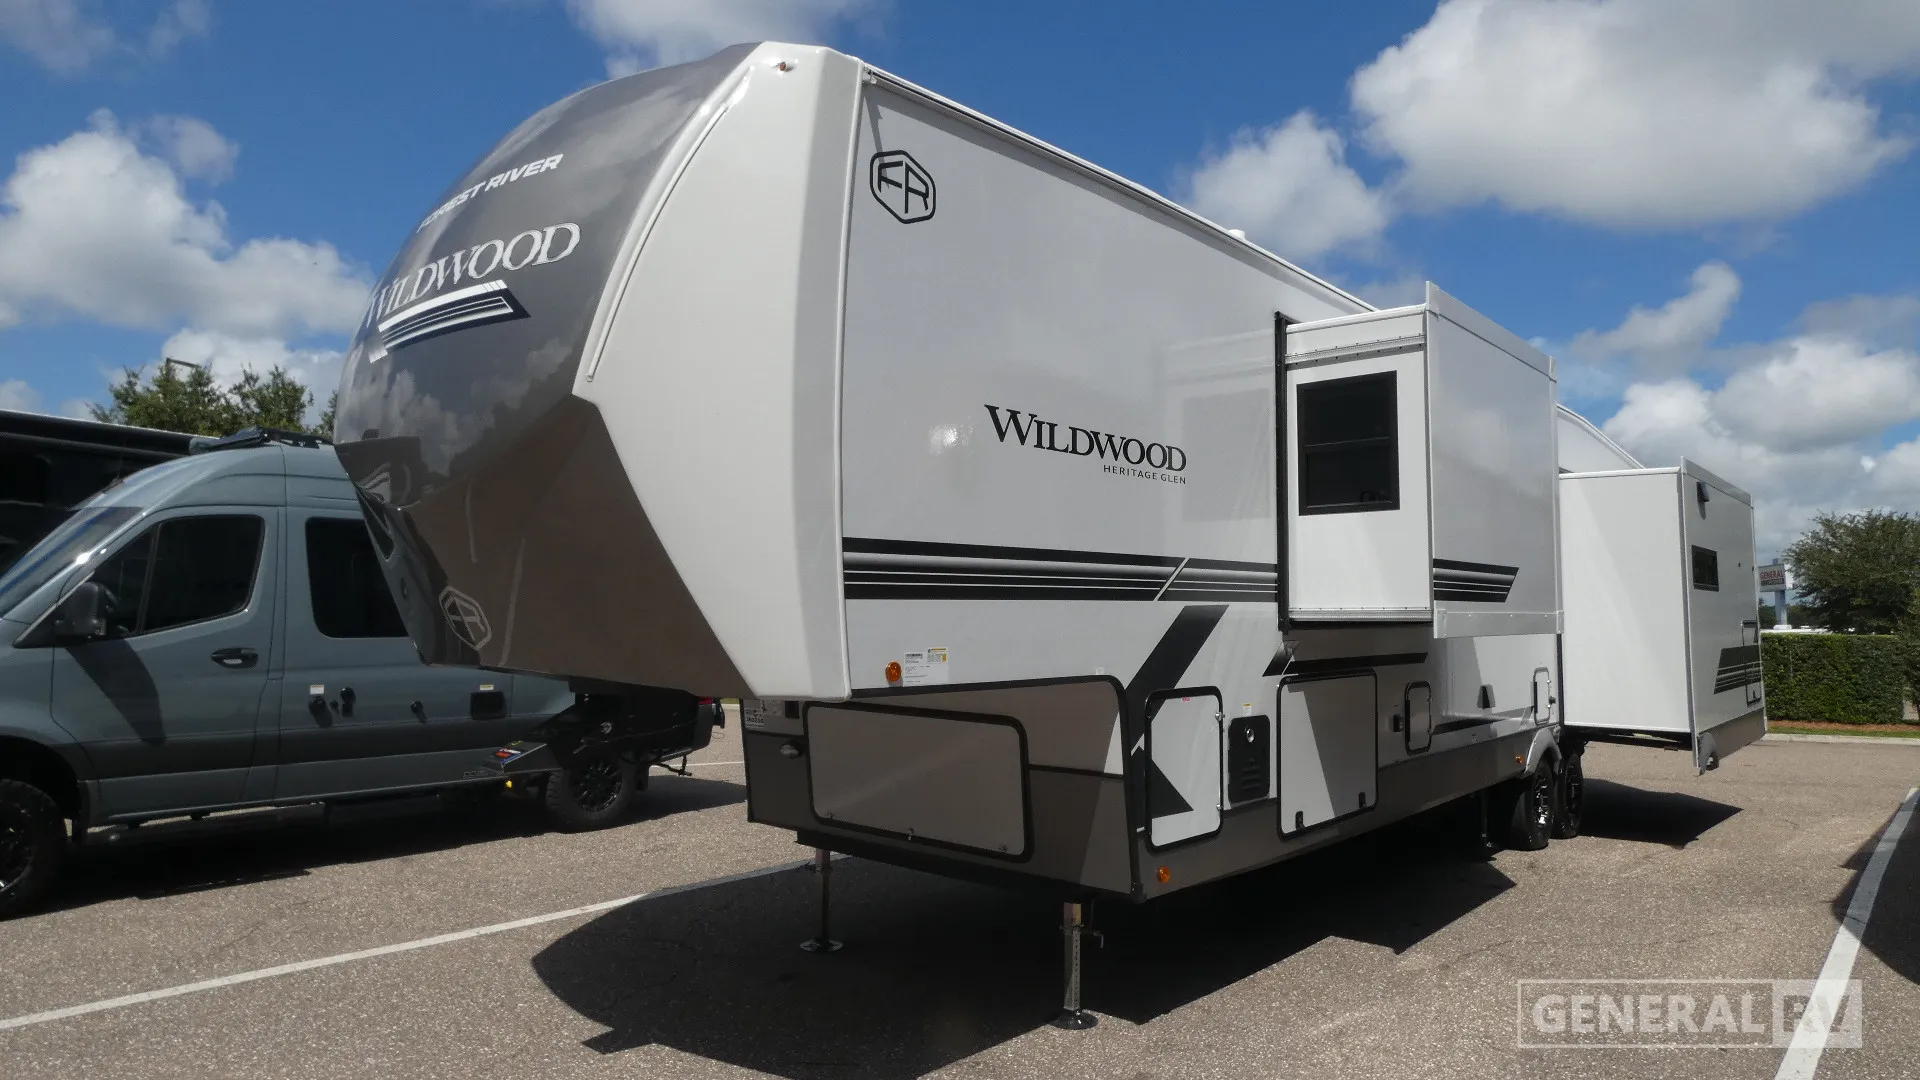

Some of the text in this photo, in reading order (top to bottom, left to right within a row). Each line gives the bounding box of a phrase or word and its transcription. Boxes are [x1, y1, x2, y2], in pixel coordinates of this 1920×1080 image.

[417, 153, 564, 233] FOREST RIVER
[366, 222, 581, 328] WILDWOOD
[984, 404, 1187, 473] WILDWOOD
[1103, 464, 1187, 485] HERITAGE GLEN
